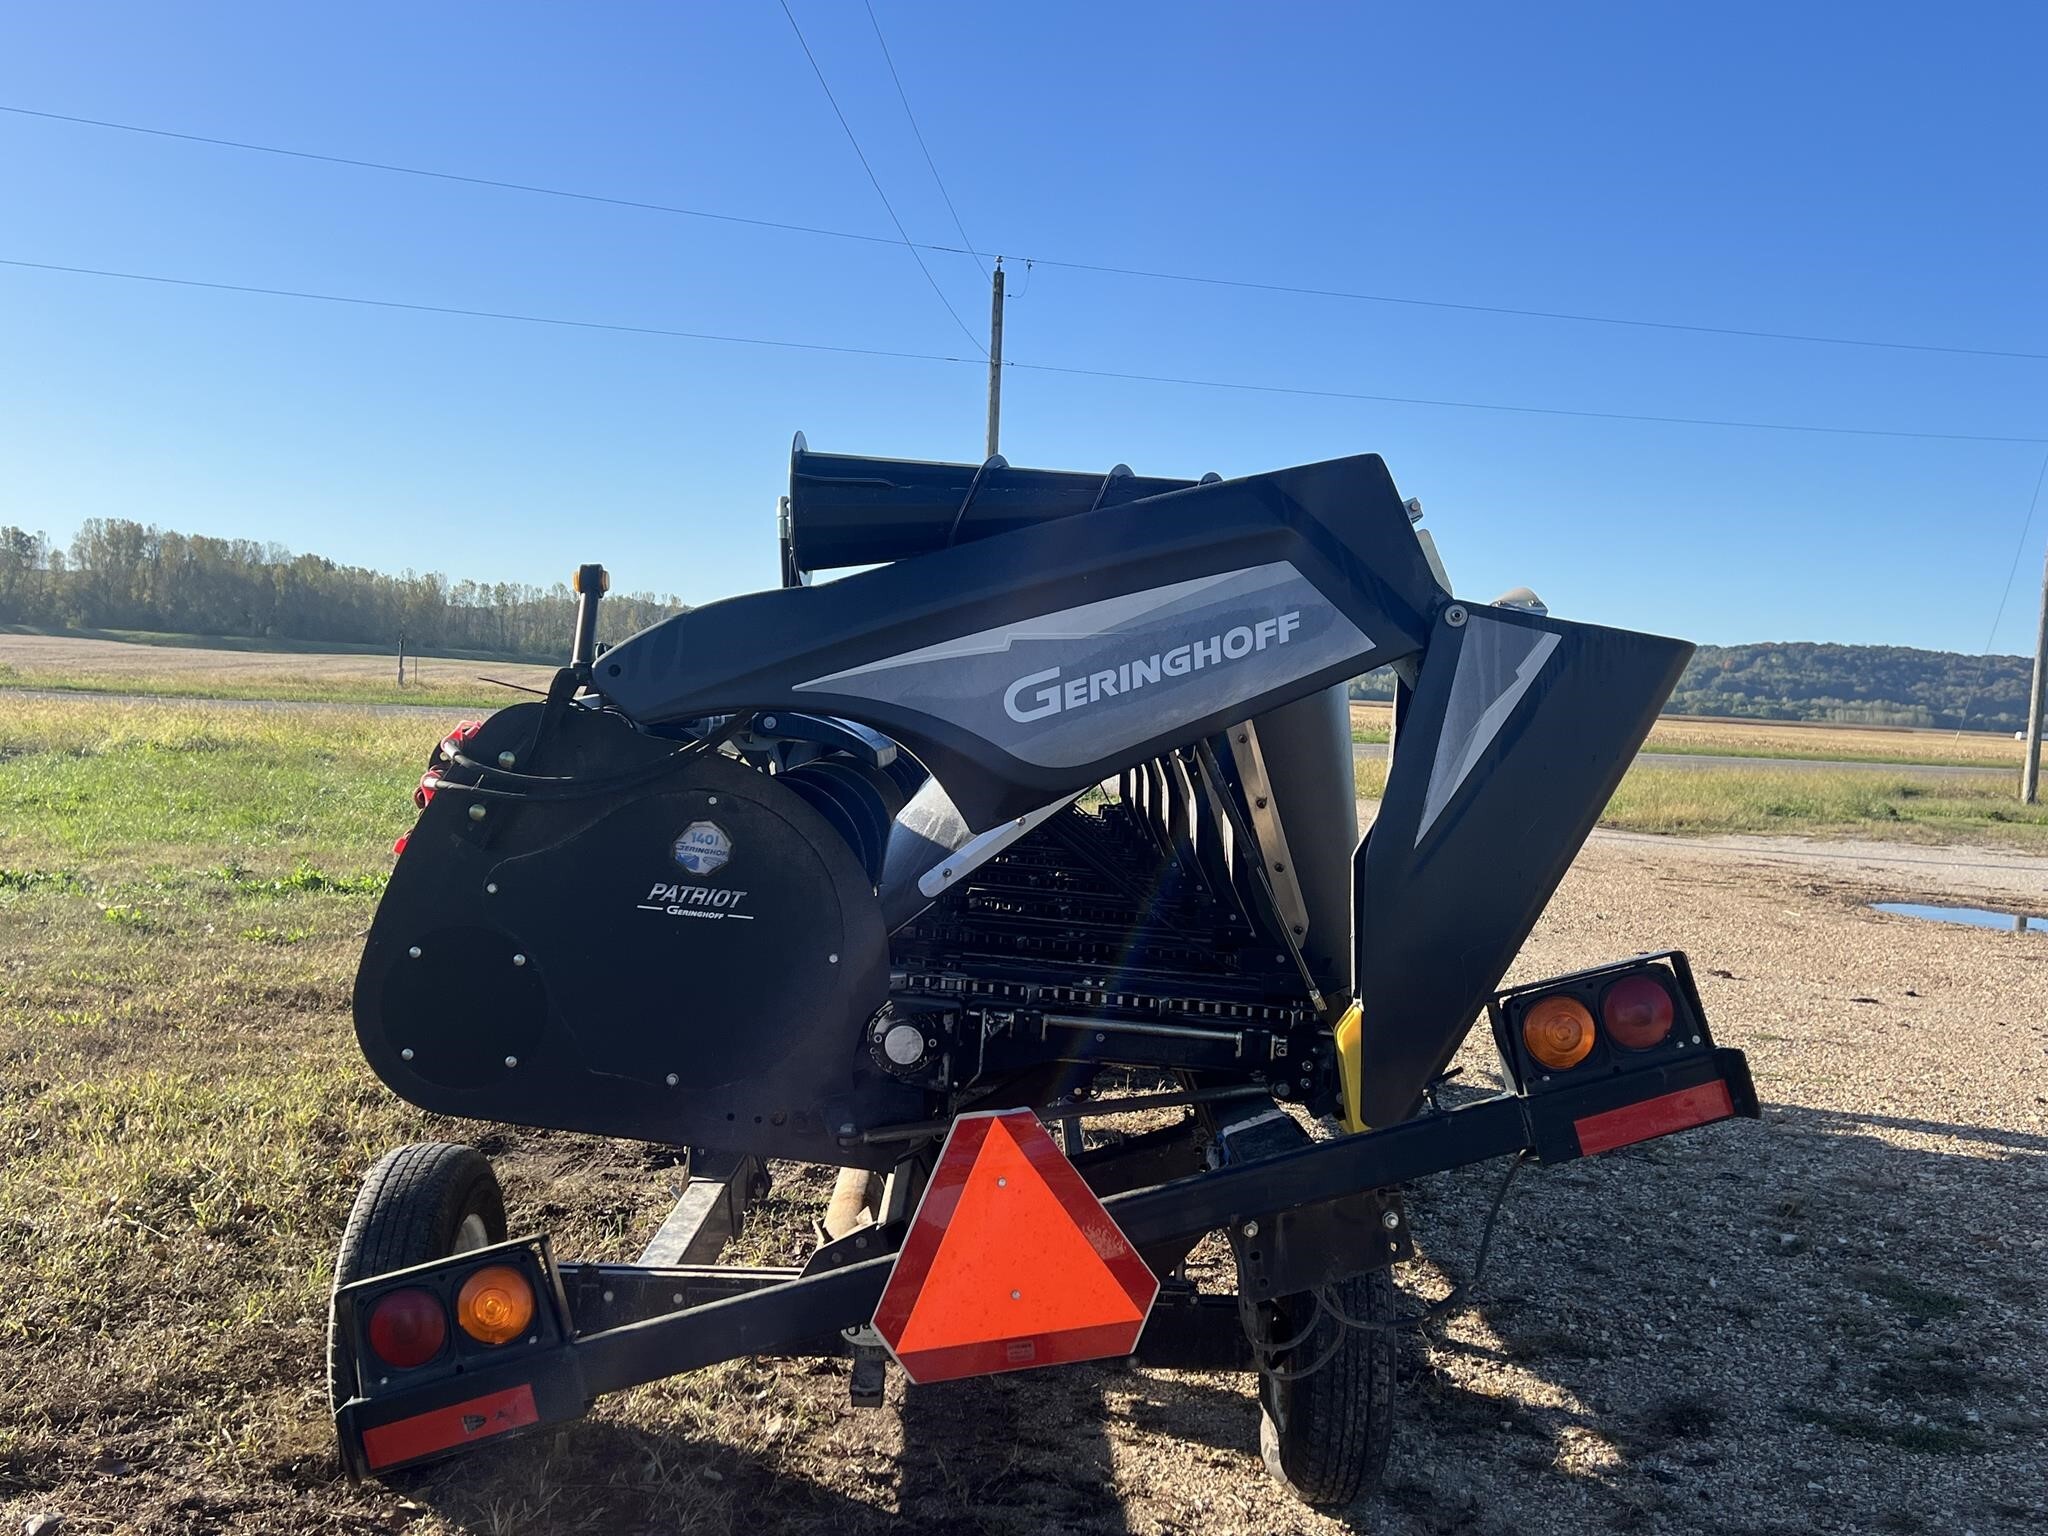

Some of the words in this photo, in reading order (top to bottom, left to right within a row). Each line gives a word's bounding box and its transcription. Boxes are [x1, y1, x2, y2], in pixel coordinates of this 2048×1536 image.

[1003, 611, 1300, 723] GERINGHOFF
[647, 883, 748, 908] PATRIOT
[667, 905, 725, 919] GERINGHOFF
